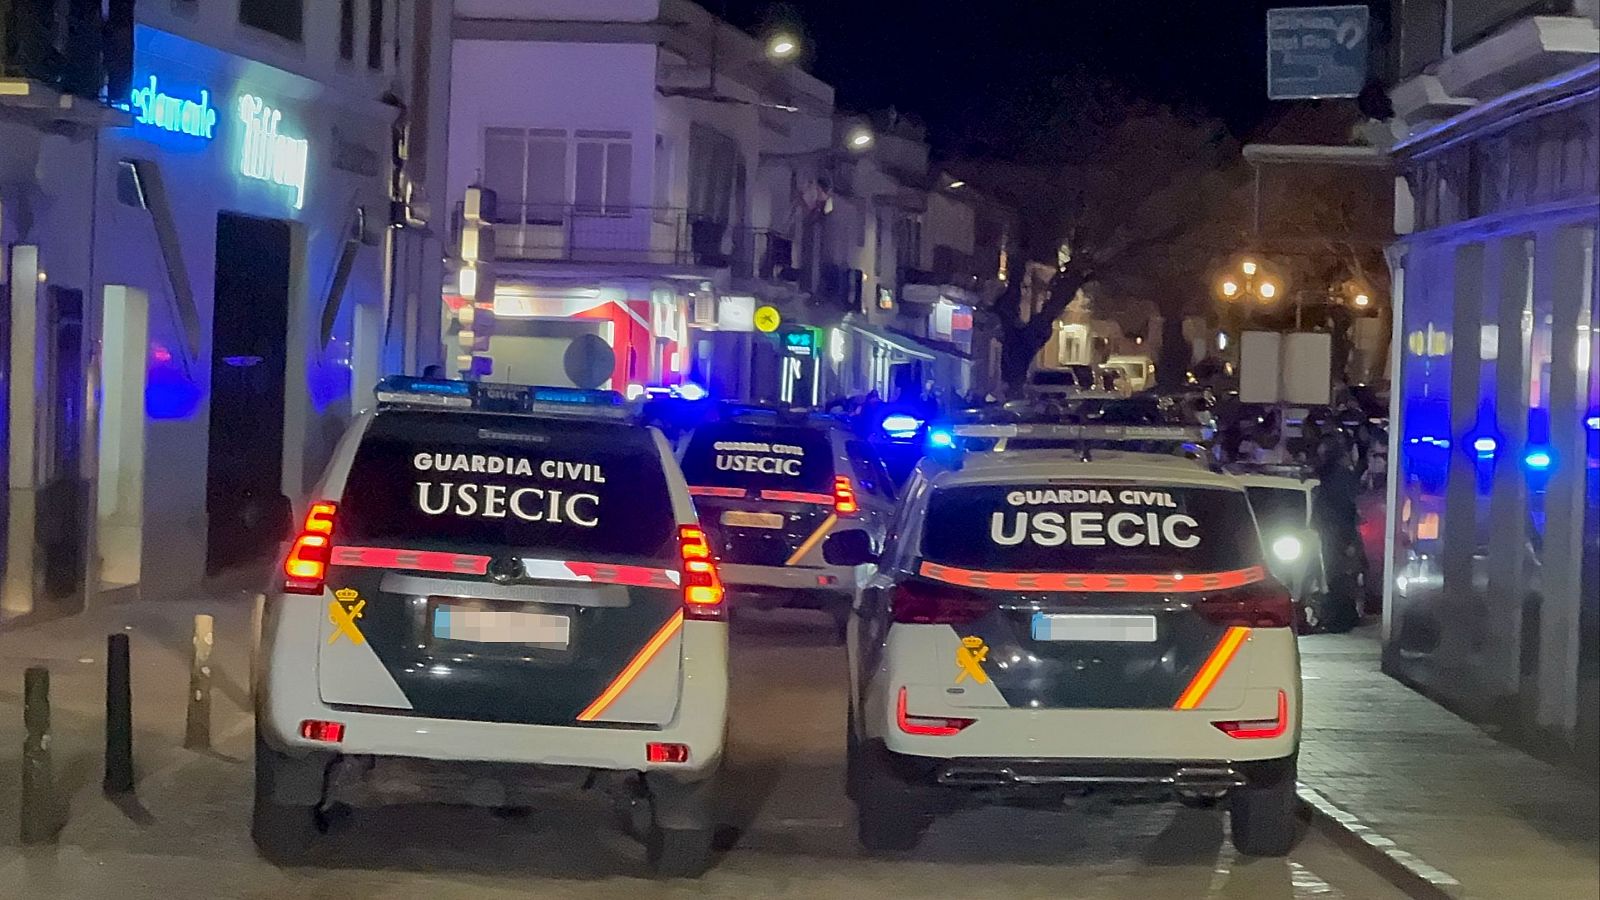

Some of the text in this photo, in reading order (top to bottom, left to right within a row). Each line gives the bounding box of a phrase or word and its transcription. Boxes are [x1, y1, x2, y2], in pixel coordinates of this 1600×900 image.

[122, 75, 216, 139] estaurante
[414, 453, 605, 482] GUARDIA CIVIL
[715, 454, 803, 476] USECIC
[416, 482, 600, 527] USECIC
[1007, 490, 1176, 507] GUARDIA CIVIL
[992, 512, 1200, 547] USECIC
[431, 582, 483, 597] LAND
